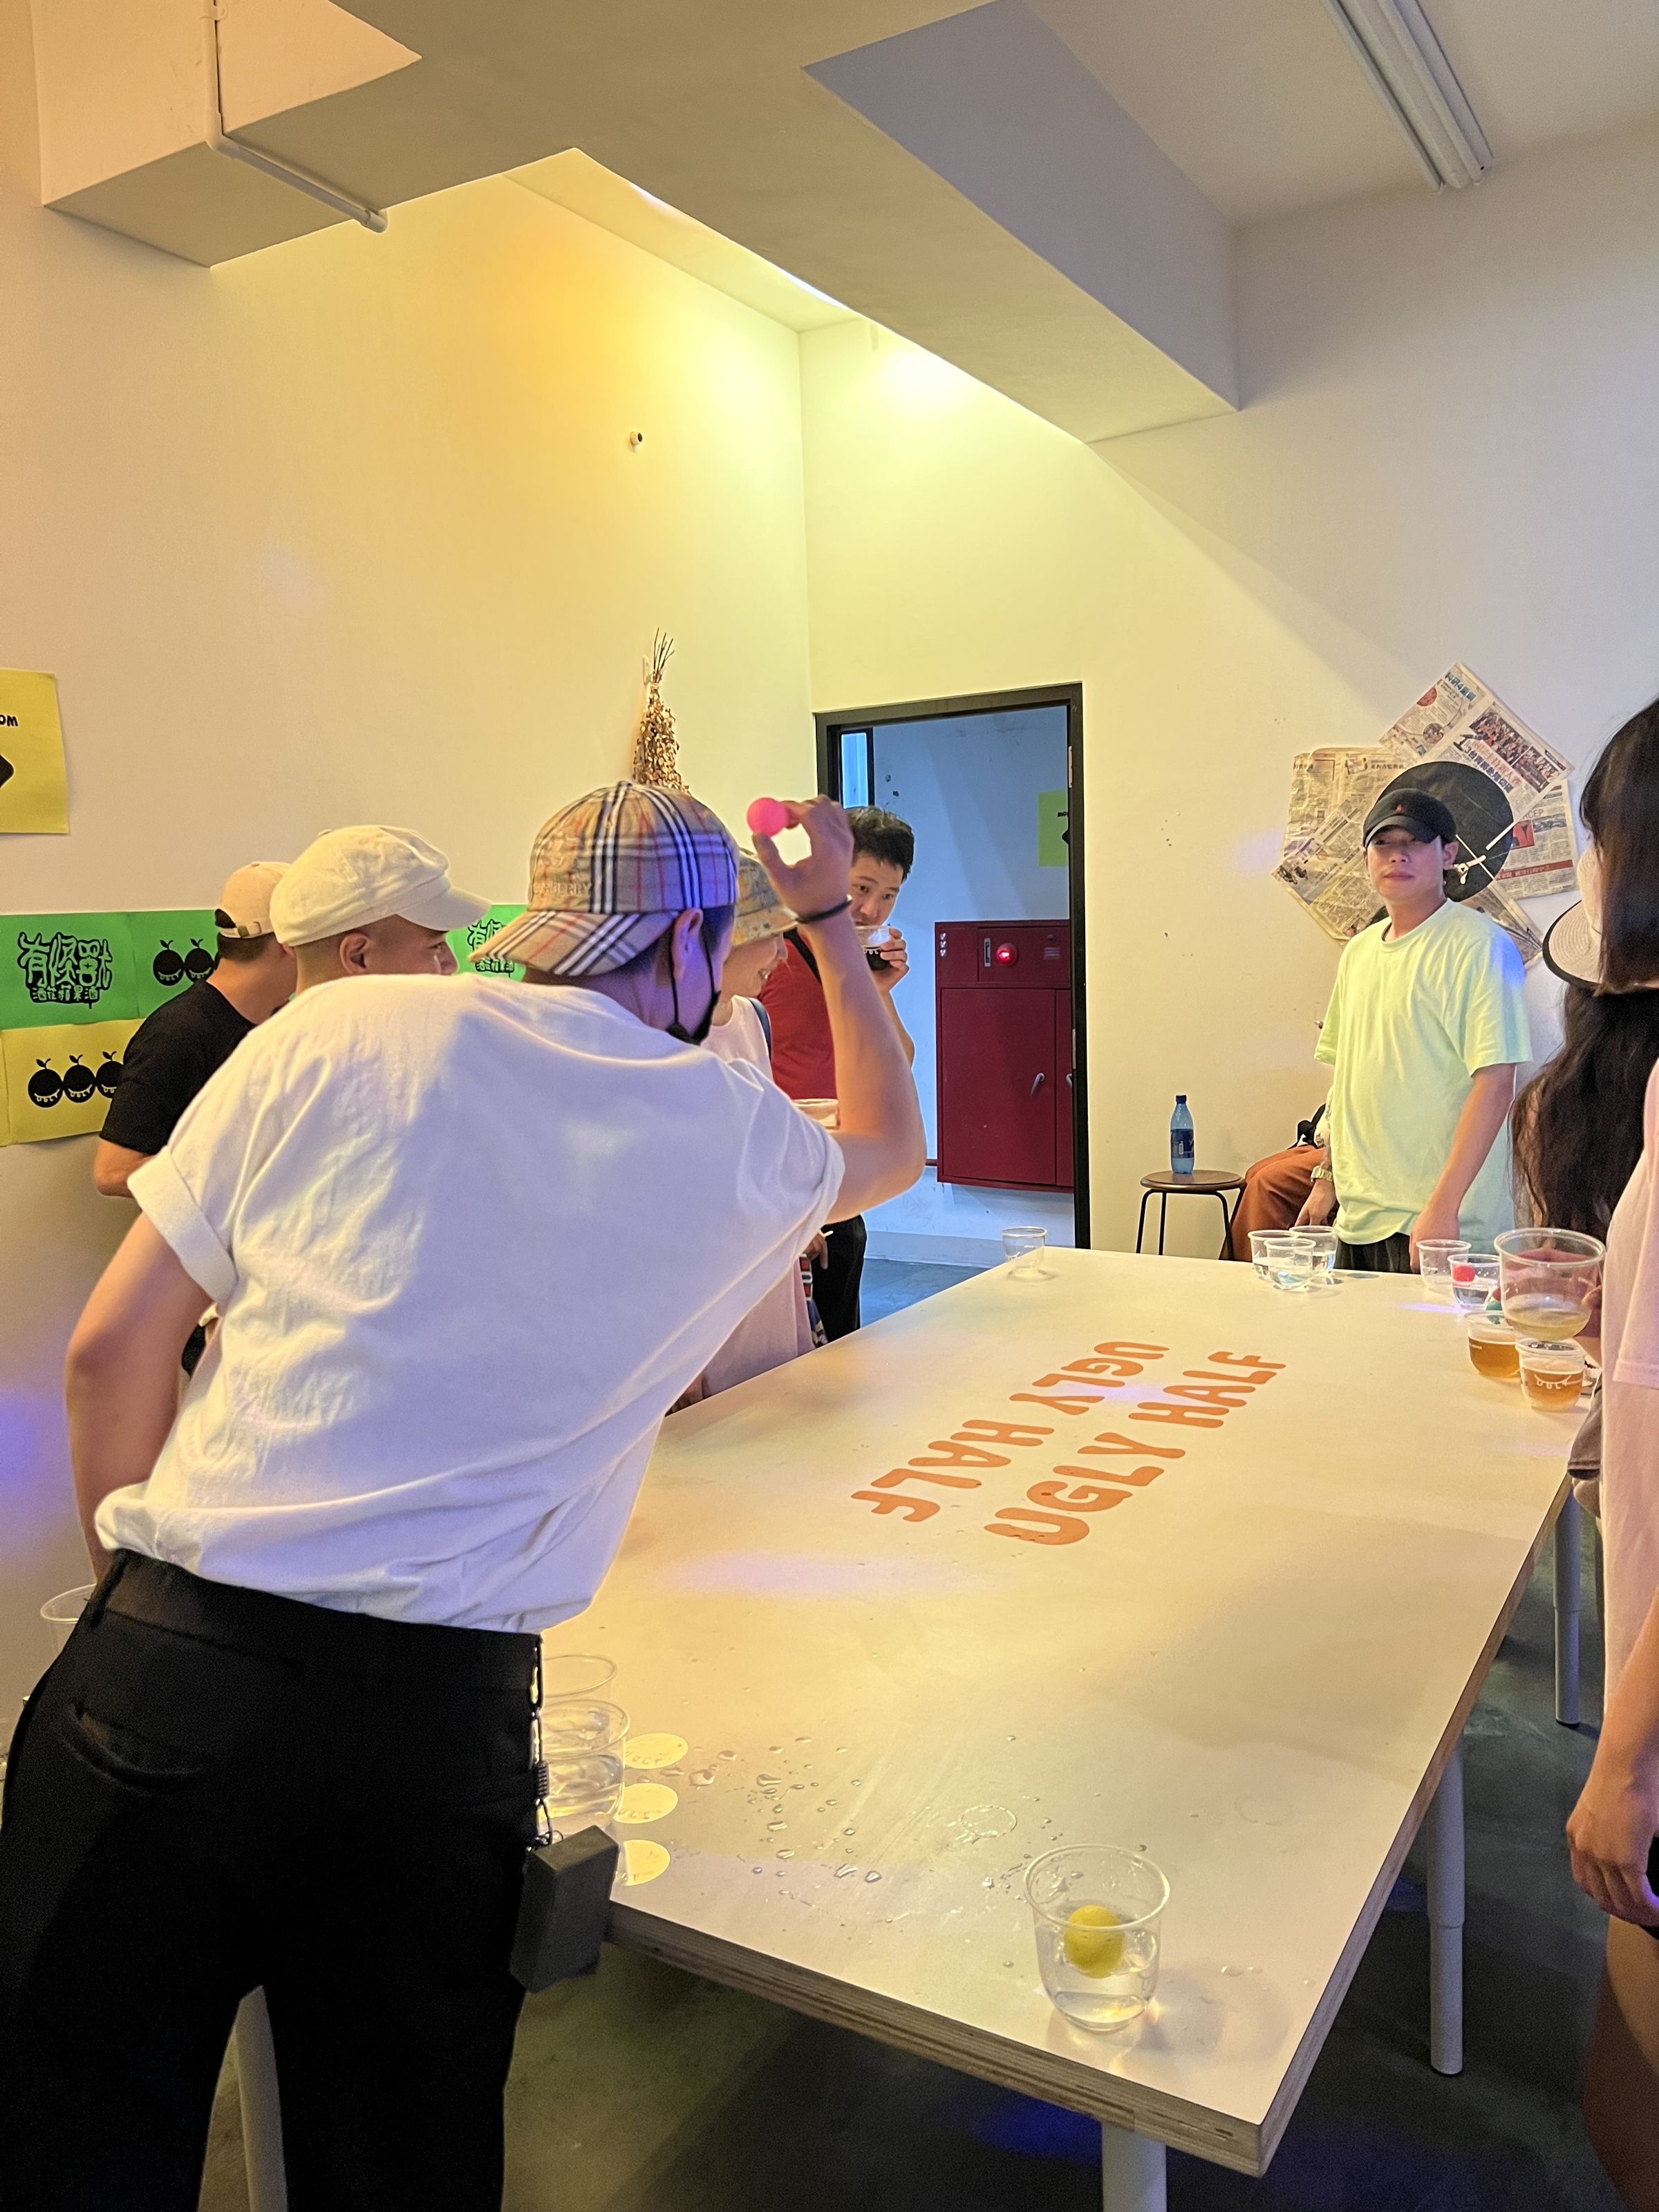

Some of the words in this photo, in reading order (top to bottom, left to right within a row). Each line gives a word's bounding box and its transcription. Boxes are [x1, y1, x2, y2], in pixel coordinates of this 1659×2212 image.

[1009, 1342, 1170, 1415] UGLY
[851, 1420, 1054, 1522] HALF
[984, 1432, 1185, 1545] UGLY
[1128, 1351, 1286, 1428] HALF
